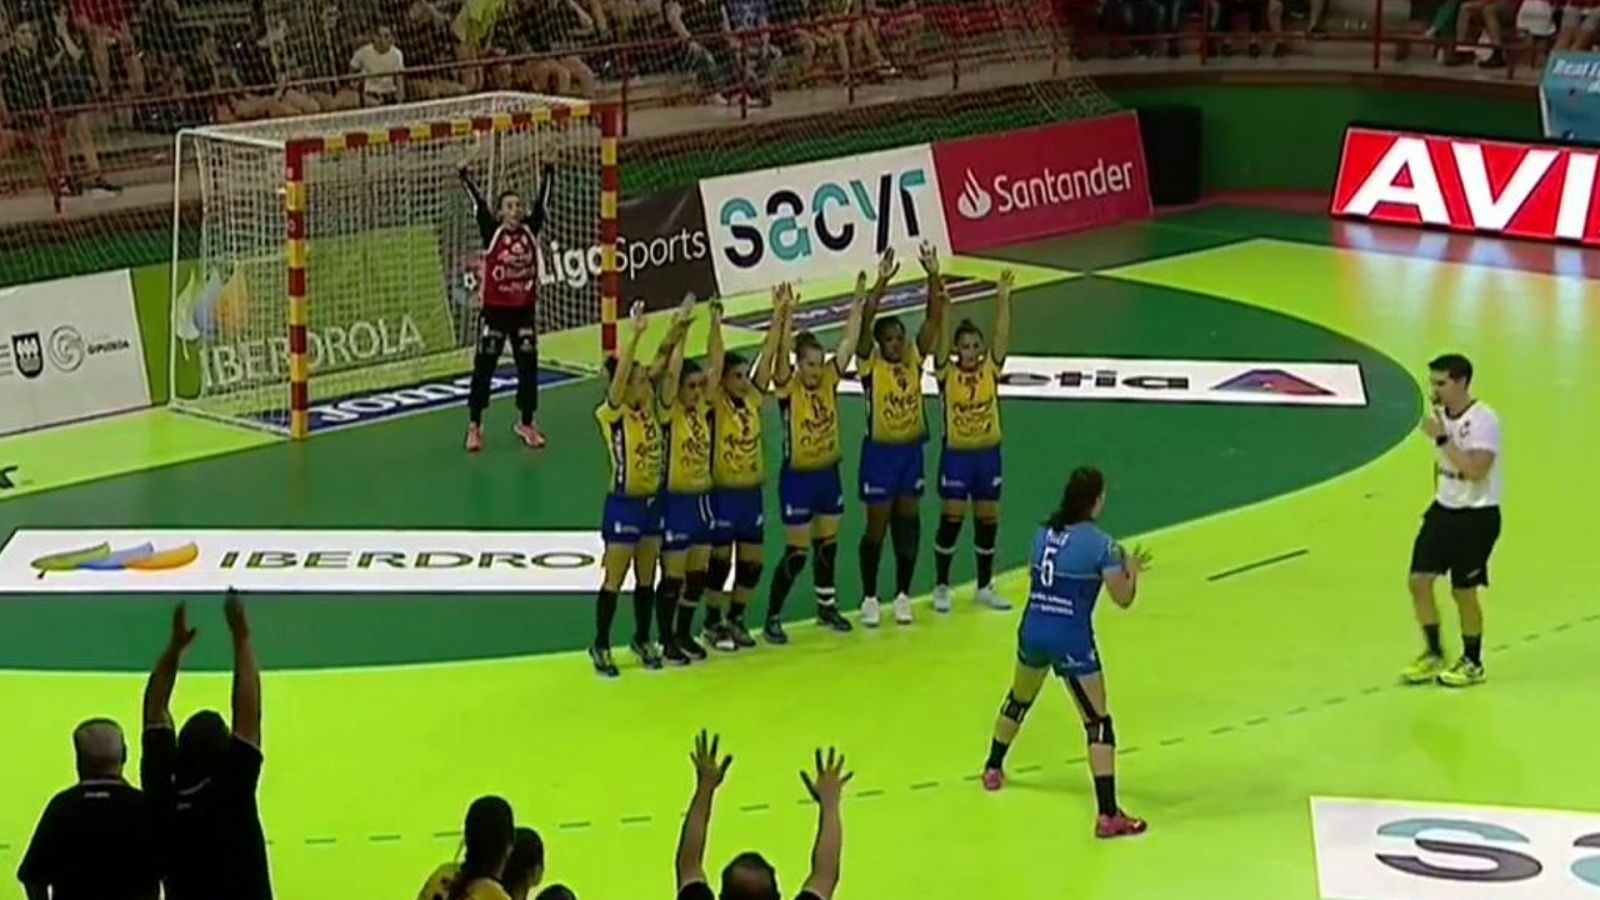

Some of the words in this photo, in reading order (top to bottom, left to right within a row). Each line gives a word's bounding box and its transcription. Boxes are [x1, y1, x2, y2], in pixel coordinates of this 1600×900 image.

[720, 169, 926, 269] sacyr
[994, 159, 1133, 214] Santander
[1342, 136, 1600, 241] AVI
[201, 314, 426, 388] IBERDROLA
[220, 550, 596, 569] IBERDRO
[1375, 817, 1600, 889] s
